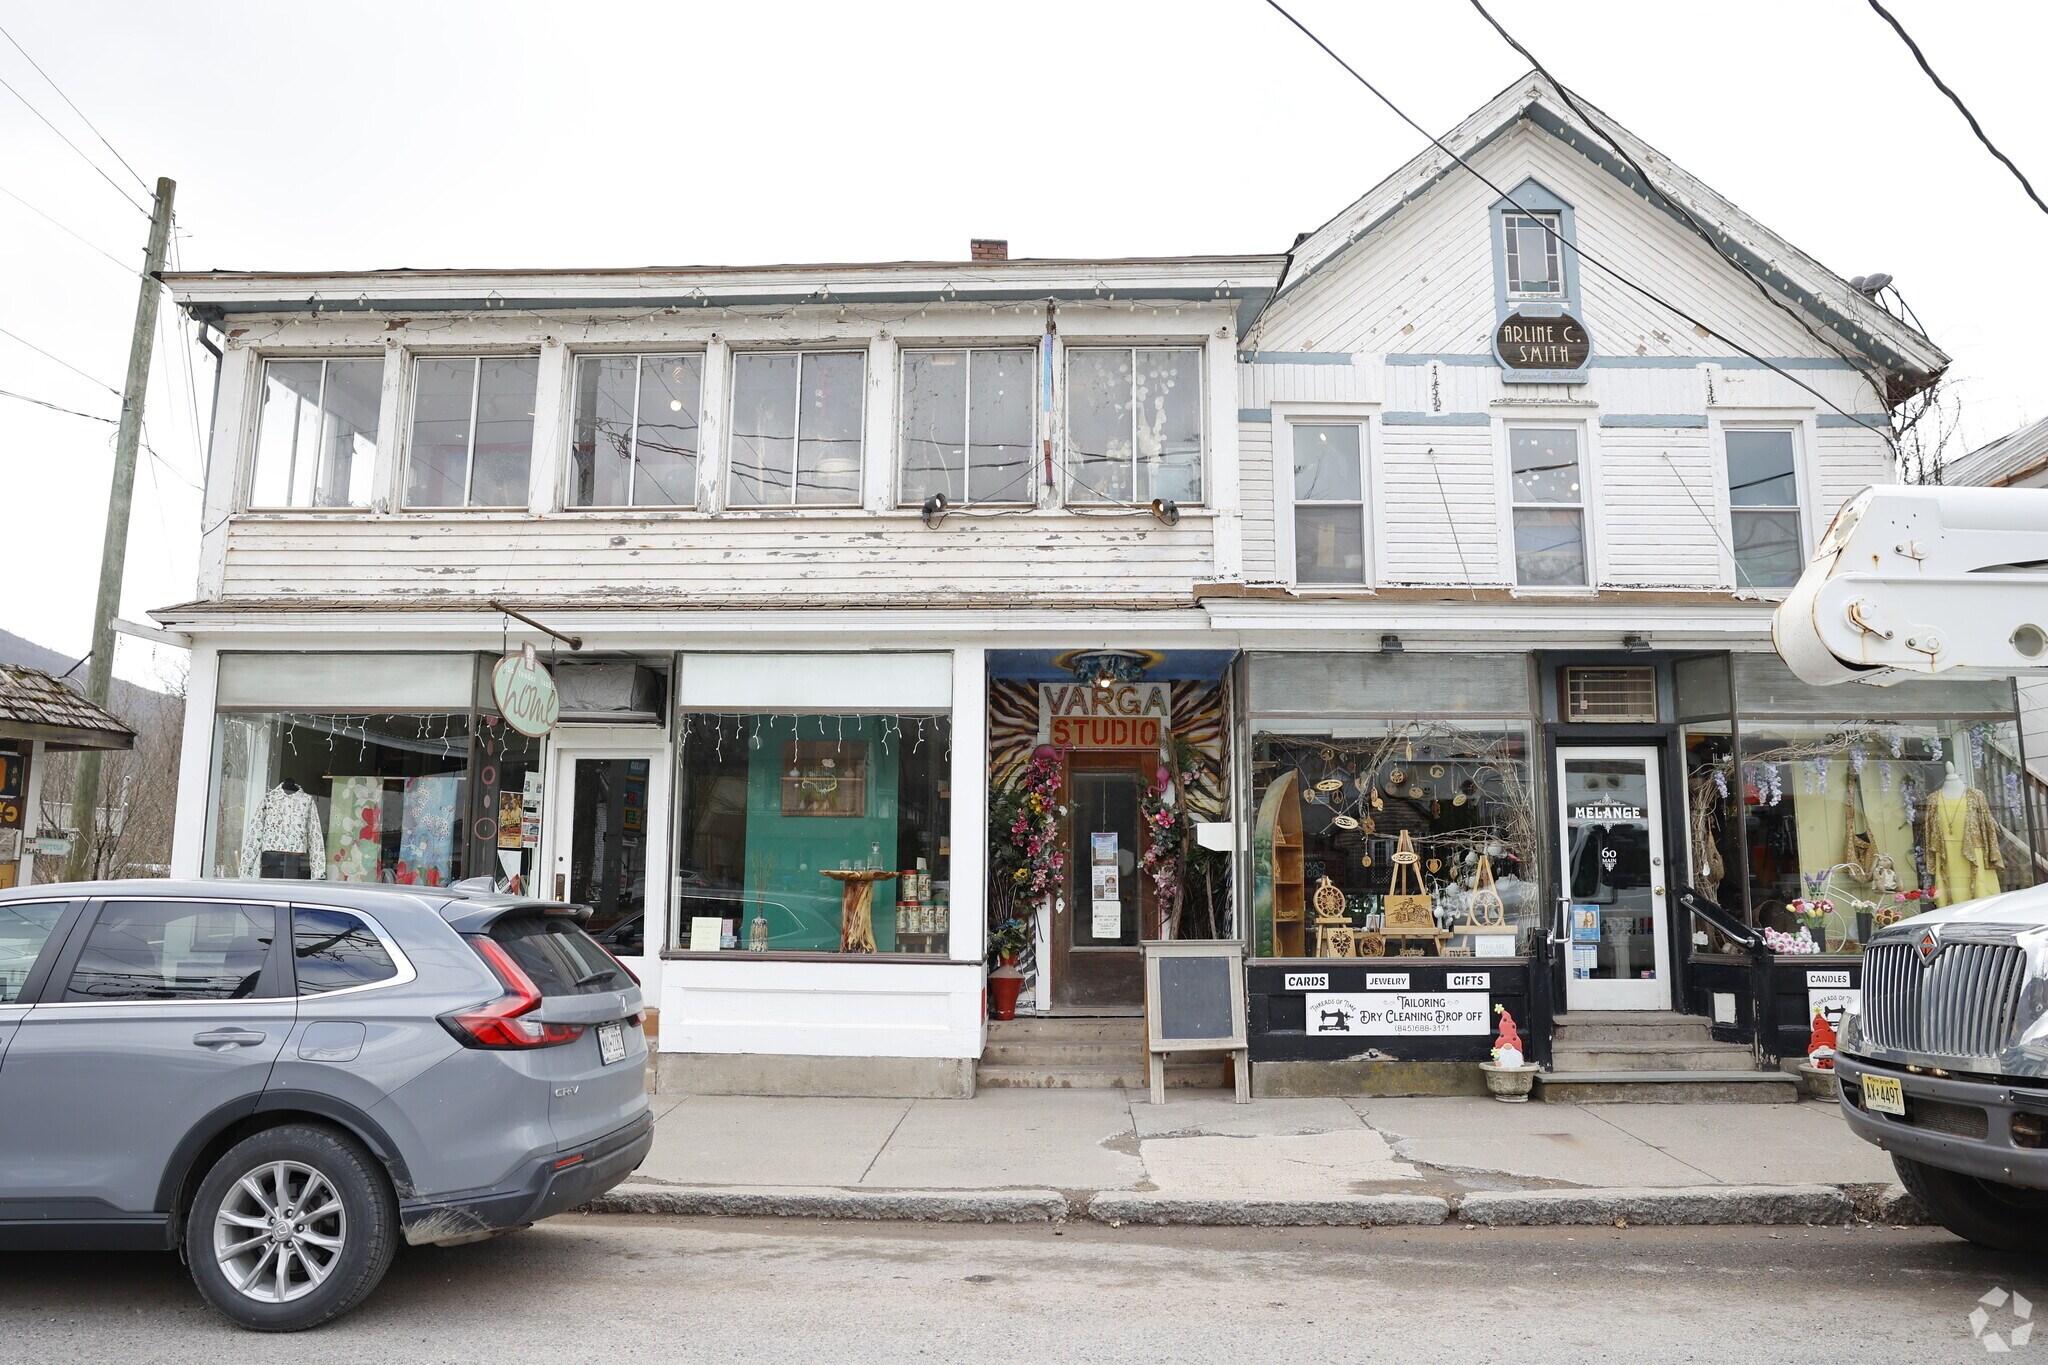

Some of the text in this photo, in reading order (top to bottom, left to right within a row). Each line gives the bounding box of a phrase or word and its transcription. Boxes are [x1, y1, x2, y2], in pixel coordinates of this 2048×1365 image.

[1504, 325, 1581, 343] ARLINE C.
[1520, 345, 1569, 362] SMITH
[1506, 371, 1586, 383] Memorial Building
[1043, 686, 1168, 716] VARGA
[1053, 718, 1158, 746] STUDIO
[1575, 806, 1641, 819] MELANGE
[1601, 847, 1617, 859] 60
[1288, 977, 1326, 987] CARDS
[1453, 976, 1484, 986] GIFTS
[1810, 975, 1847, 983] CANDLES
[1310, 999, 1335, 1012] THREADS
[1344, 1000, 1356, 1012] TIME
[1397, 995, 1446, 1009] TAILORING
[1813, 995, 1837, 1008] THREADS
[1360, 1010, 1483, 1024] DRY CLEANING DROP OFF
[1394, 1024, 1450, 1032] (845)688-3171
